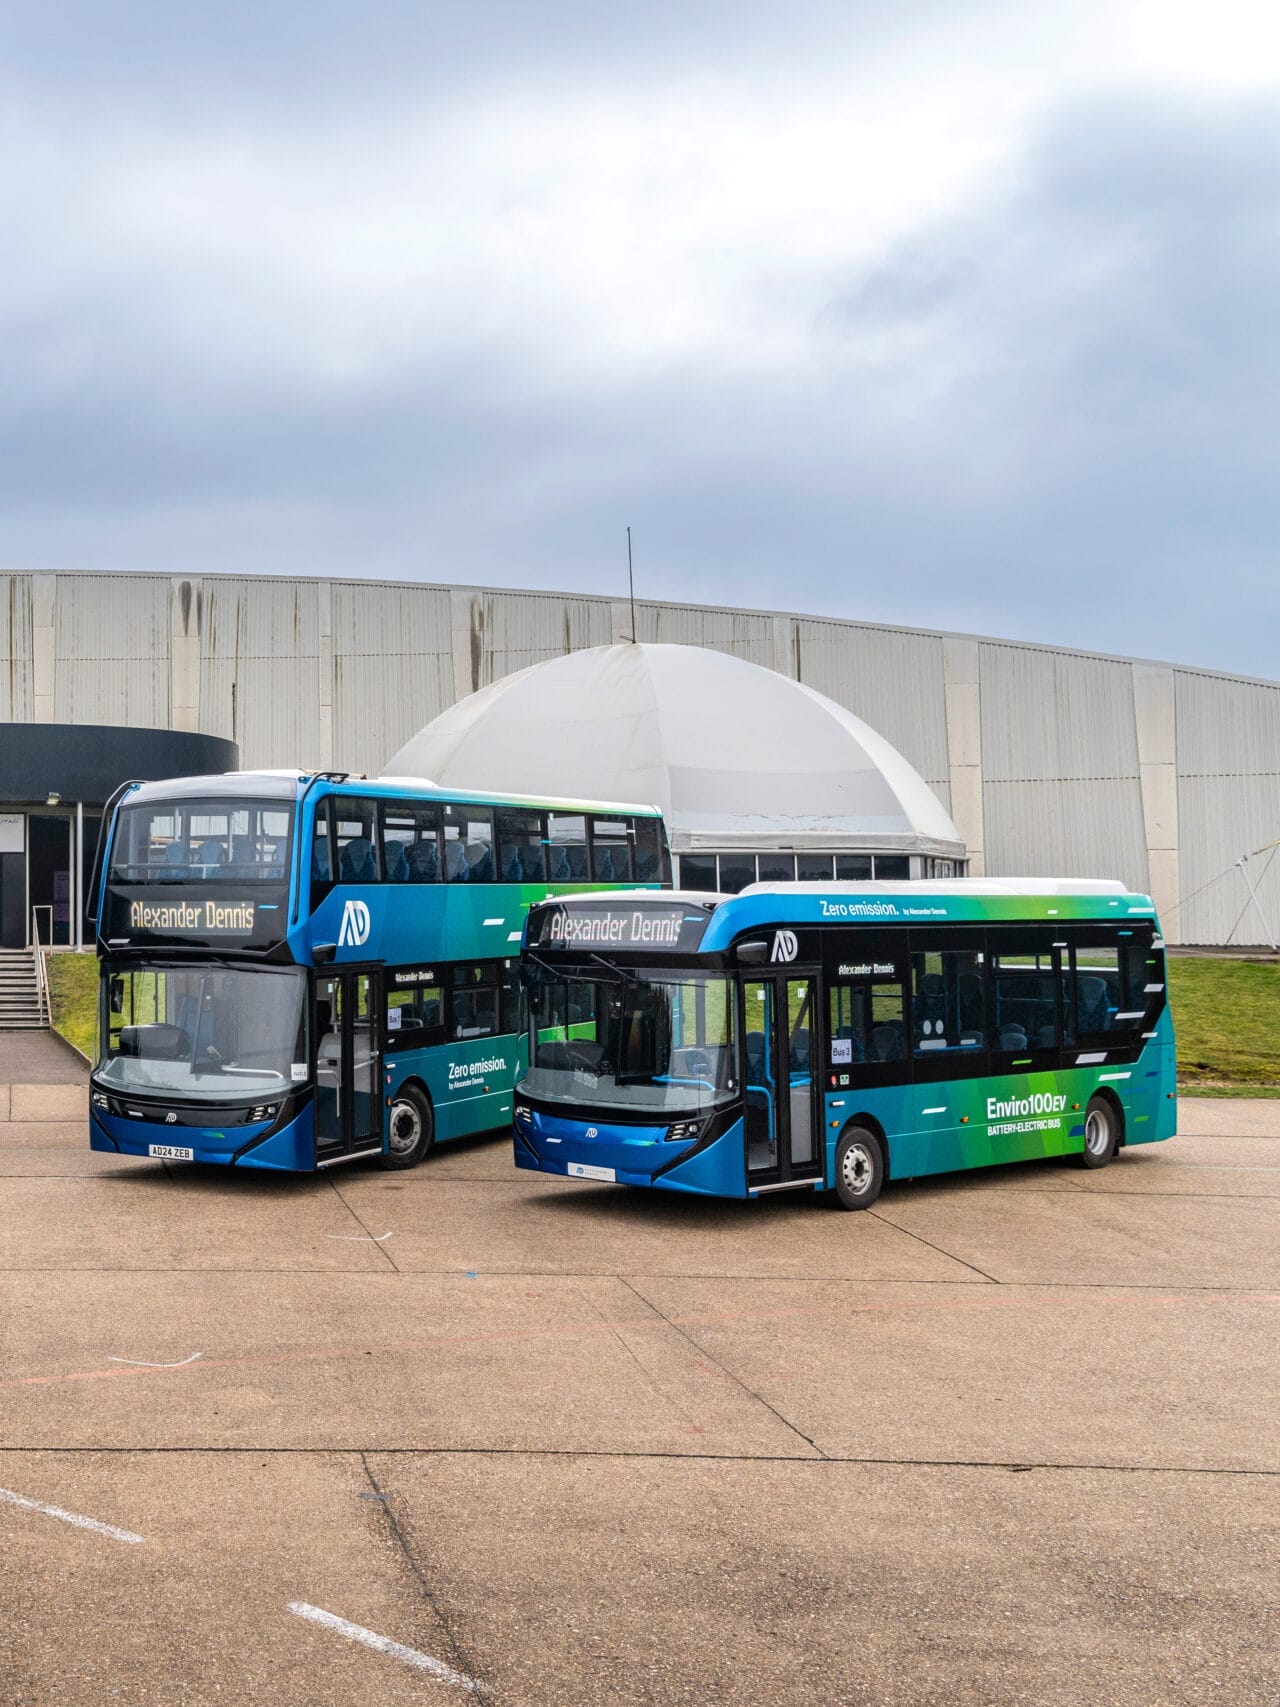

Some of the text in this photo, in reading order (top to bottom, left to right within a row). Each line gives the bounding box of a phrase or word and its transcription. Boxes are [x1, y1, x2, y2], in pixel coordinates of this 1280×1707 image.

[130, 900, 255, 929] Alexander Dennis
[819, 900, 900, 916] Zero emission.
[550, 911, 683, 942] Alexander Dennis
[838, 963, 895, 975] Alexander Dennis
[832, 1047, 851, 1056] Bus 3
[448, 1055, 507, 1080] Zero emission.
[448, 1077, 485, 1091] by Alexander Dennis
[987, 1093, 1066, 1119] Enviro100EV
[987, 1118, 1060, 1136] BATTERY-ELECTRIC BUS
[152, 1146, 190, 1158] AD24 ZEB
